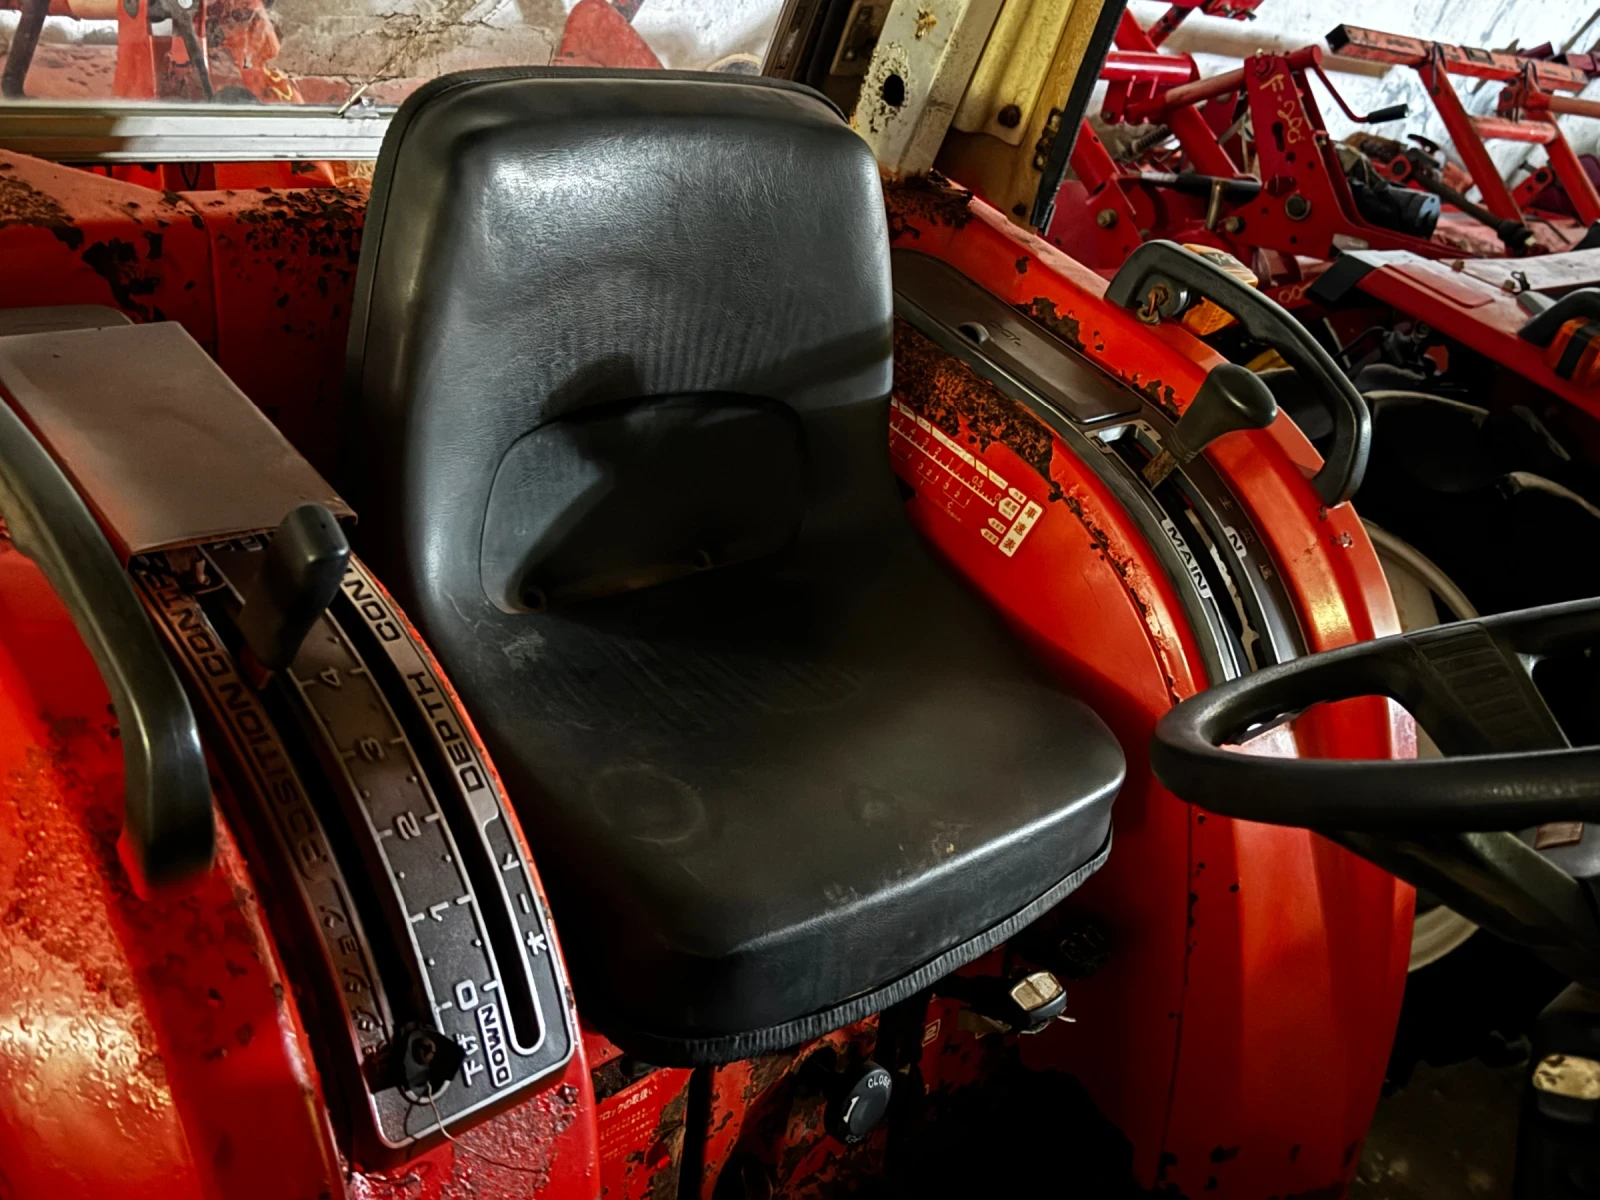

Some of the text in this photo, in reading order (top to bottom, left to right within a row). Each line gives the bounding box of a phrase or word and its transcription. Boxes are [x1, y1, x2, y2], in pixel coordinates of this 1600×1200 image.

[1229, 532, 1242, 552] N
[1167, 526, 1207, 592] MAIN
[320, 666, 343, 688] 4
[343, 567, 485, 792] DEPTH CON
[359, 736, 385, 761] 3
[396, 811, 421, 840] 2
[429, 901, 449, 921] 1
[502, 853, 547, 955] オート
[455, 979, 479, 1011] 0
[457, 1033, 484, 1087] 下げ
[481, 1006, 510, 1084] DOWN
[867, 1073, 891, 1089] CLOSE
